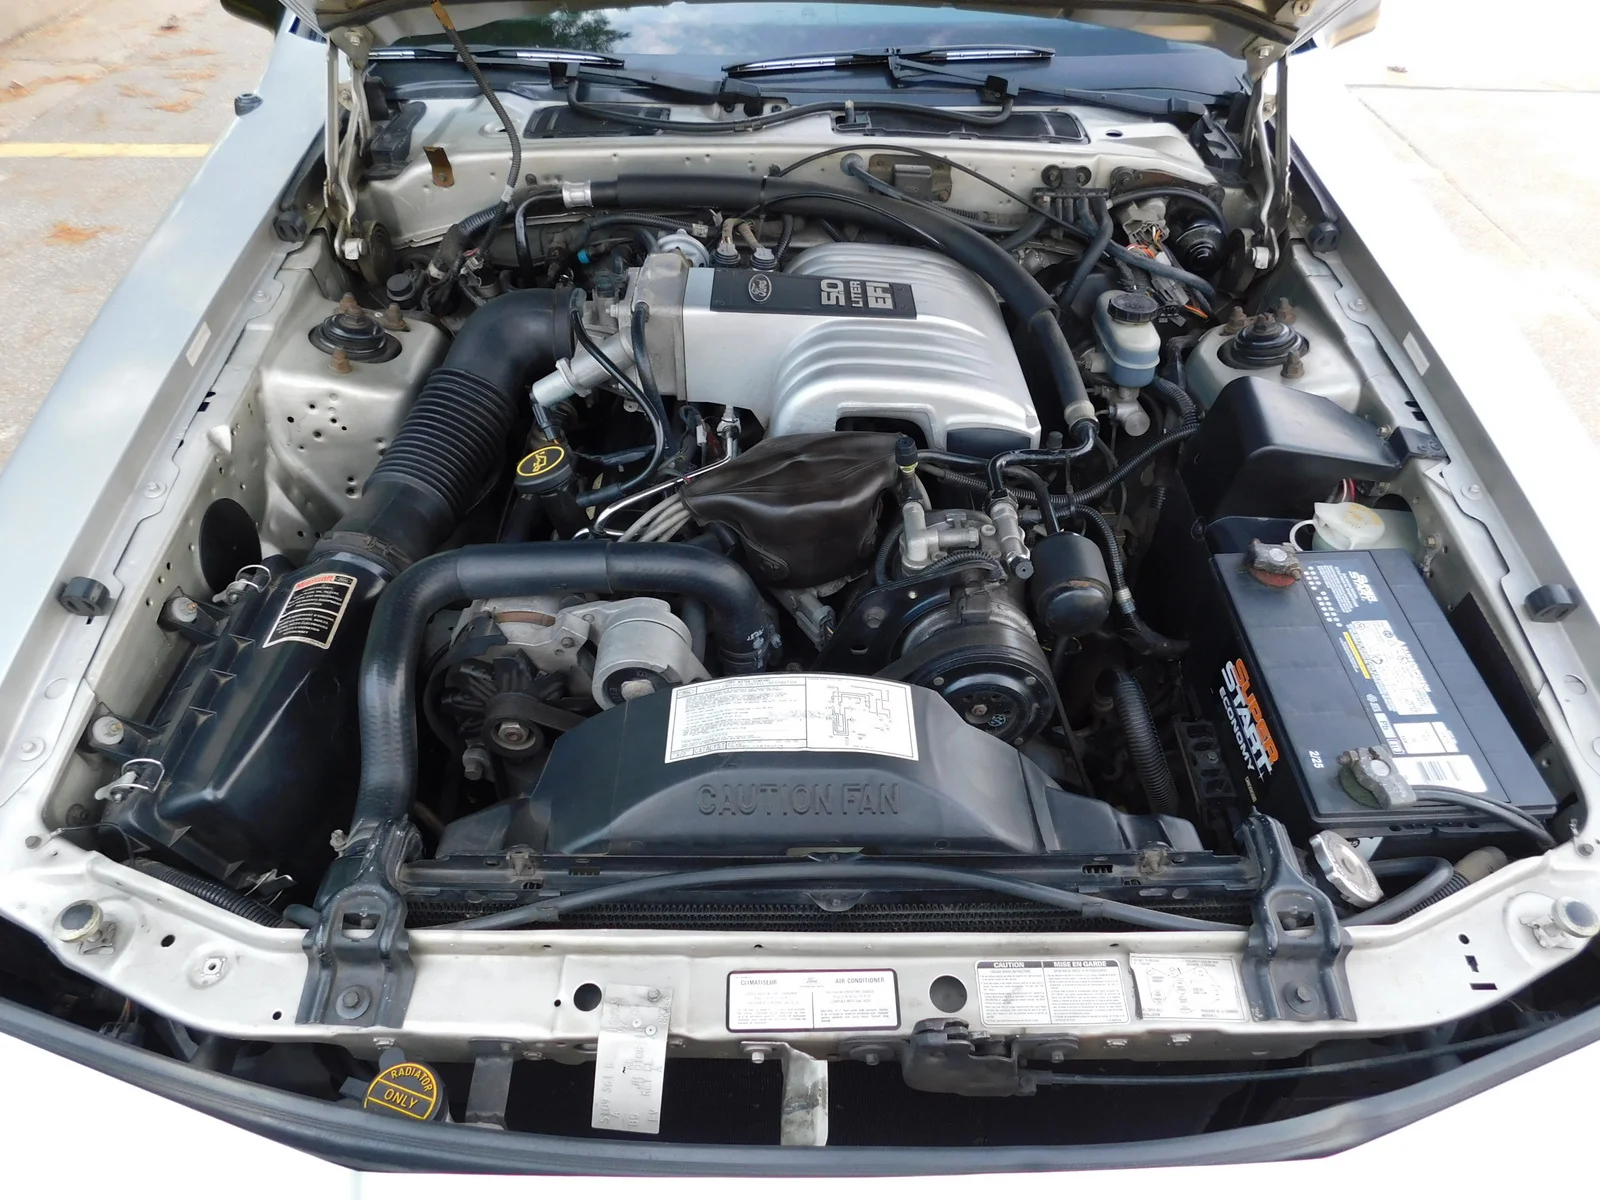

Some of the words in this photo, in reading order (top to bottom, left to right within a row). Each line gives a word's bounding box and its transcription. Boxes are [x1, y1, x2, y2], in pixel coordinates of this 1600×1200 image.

[750, 277, 770, 299] Ford
[849, 281, 864, 308] LITER
[865, 282, 894, 310] EFI
[1221, 660, 1273, 774] START
[1234, 658, 1280, 766] SUPER
[1218, 685, 1255, 772] ECONOMY
[1308, 750, 1324, 769] 2/25
[698, 783, 833, 816] CAUTION
[842, 782, 899, 816] FAN
[390, 1066, 433, 1092] RADIATOR
[384, 1088, 419, 1109] ONLY
